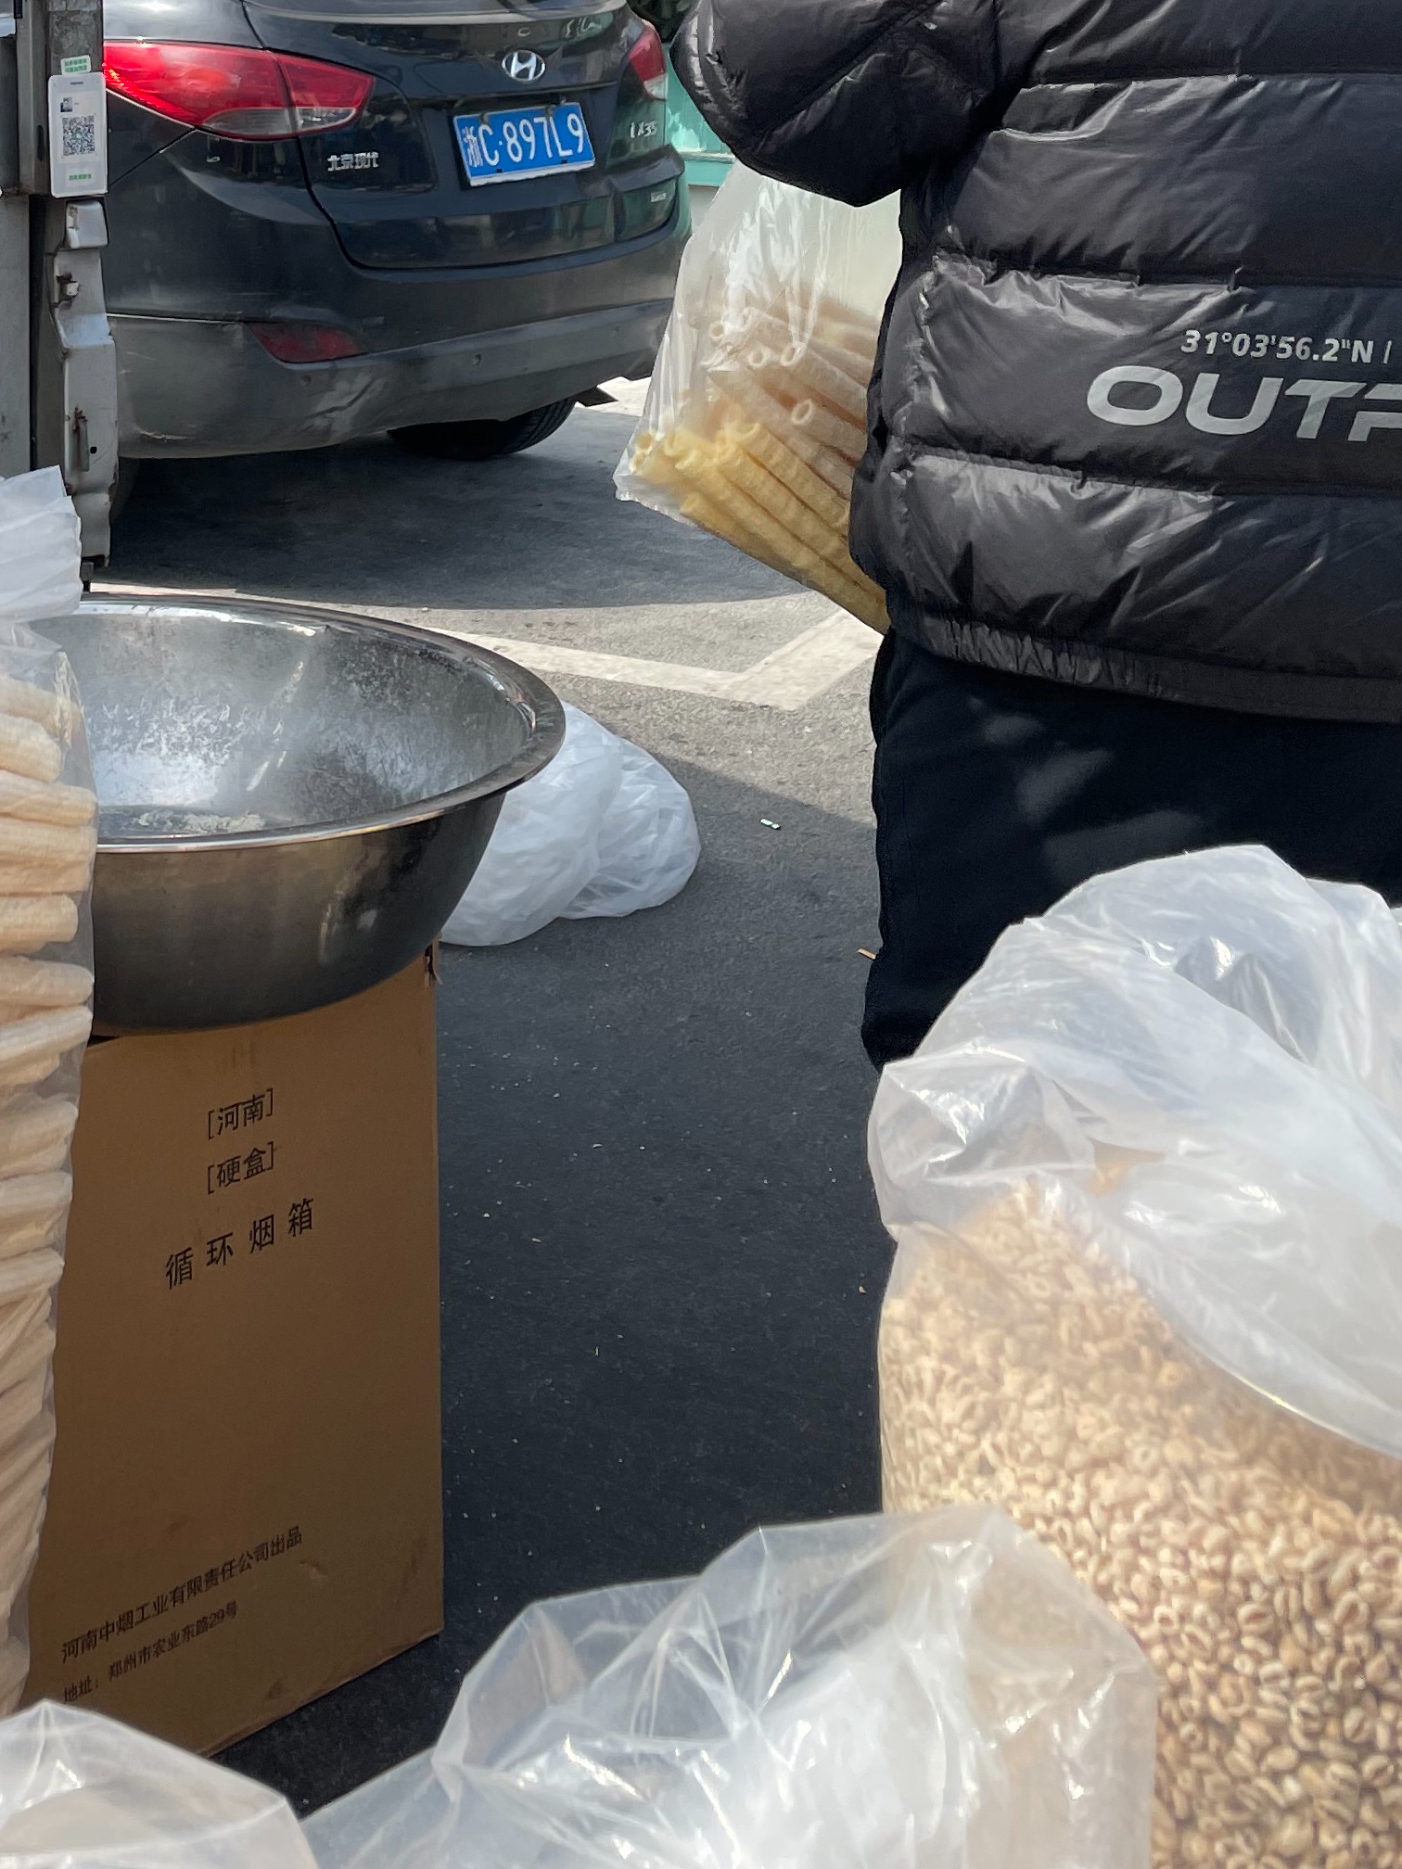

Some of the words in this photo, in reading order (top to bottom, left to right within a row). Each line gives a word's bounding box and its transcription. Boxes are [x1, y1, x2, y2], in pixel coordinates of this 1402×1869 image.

[327, 151, 379, 171] 北京现代
[165, 1197, 314, 1291] 循环烟箱
[61, 1525, 302, 1664] 河南中烟工业有限责任公司出品
[109, 1600, 238, 1681] 郑州市农业东路29号
